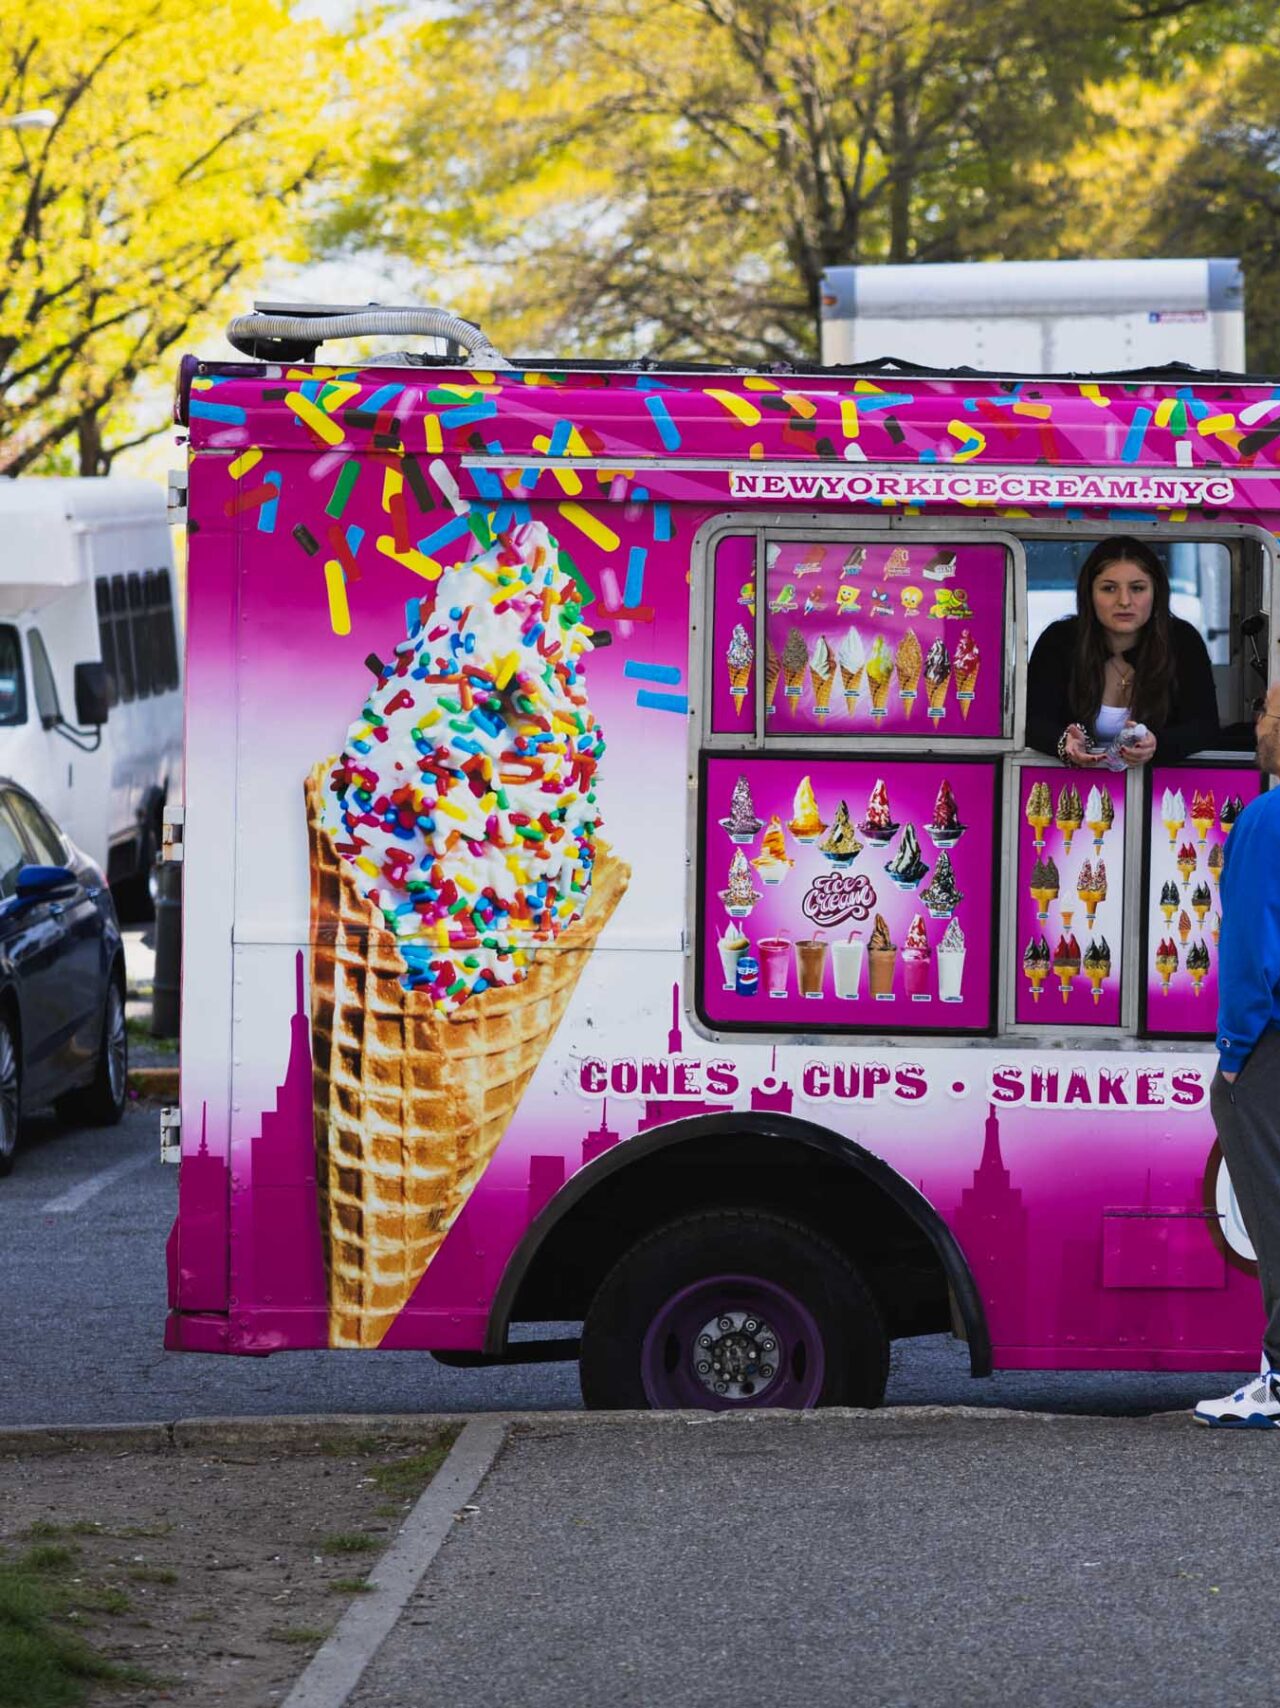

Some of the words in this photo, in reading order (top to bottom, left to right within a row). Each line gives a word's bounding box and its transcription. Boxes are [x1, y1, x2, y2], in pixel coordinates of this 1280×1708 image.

[736, 474, 1231, 501] NEWYORKICECREAM.NYC
[580, 1057, 740, 1097] CONES
[802, 1060, 928, 1100] CUPS
[992, 1064, 1205, 1106] SHAKES
